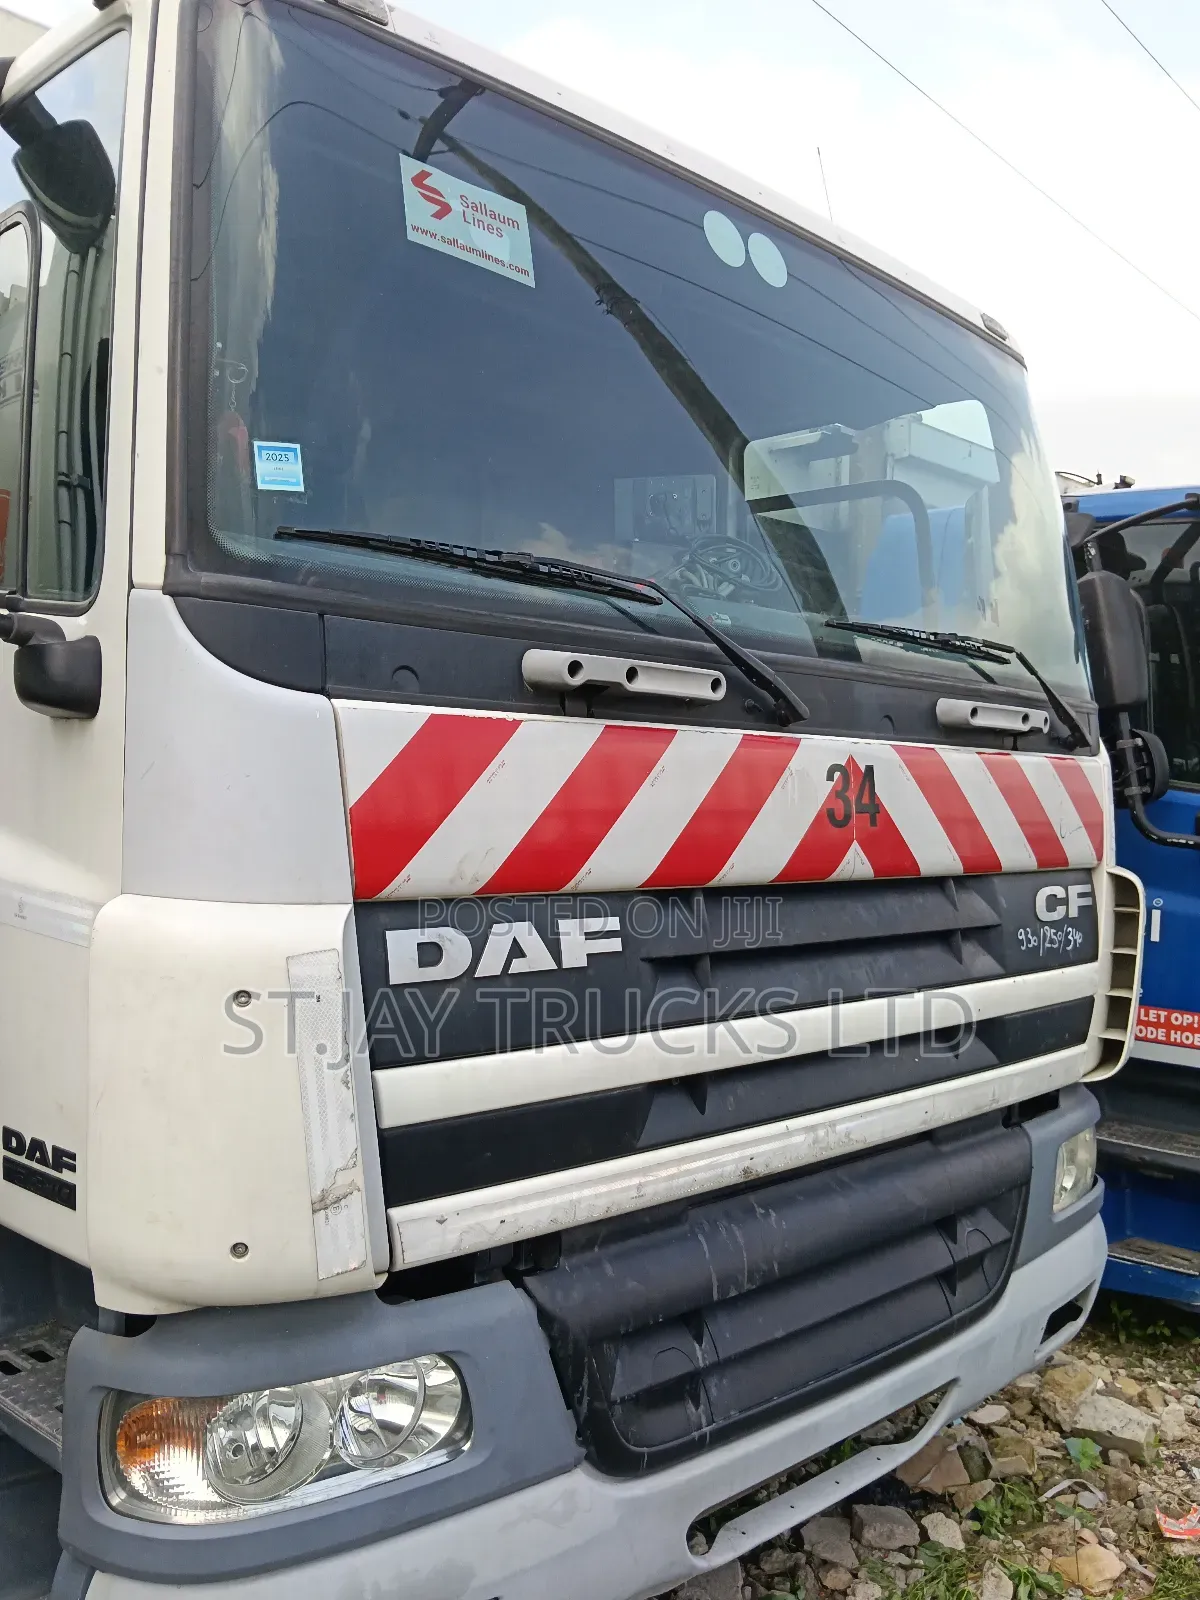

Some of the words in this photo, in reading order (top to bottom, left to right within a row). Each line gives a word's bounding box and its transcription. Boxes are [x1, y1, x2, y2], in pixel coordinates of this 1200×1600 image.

[460, 194, 520, 230] Sallaum
[462, 210, 504, 238] Lines
[411, 223, 530, 278] www.sallaumlines.com
[265, 452, 290, 462] 2025
[826, 763, 880, 828] 34
[1035, 883, 1093, 922] CF
[385, 916, 622, 985] DAF
[1139, 1008, 1168, 1024] LET
[1170, 1012, 1199, 1028] OP!
[2, 1124, 76, 1174] DAF
